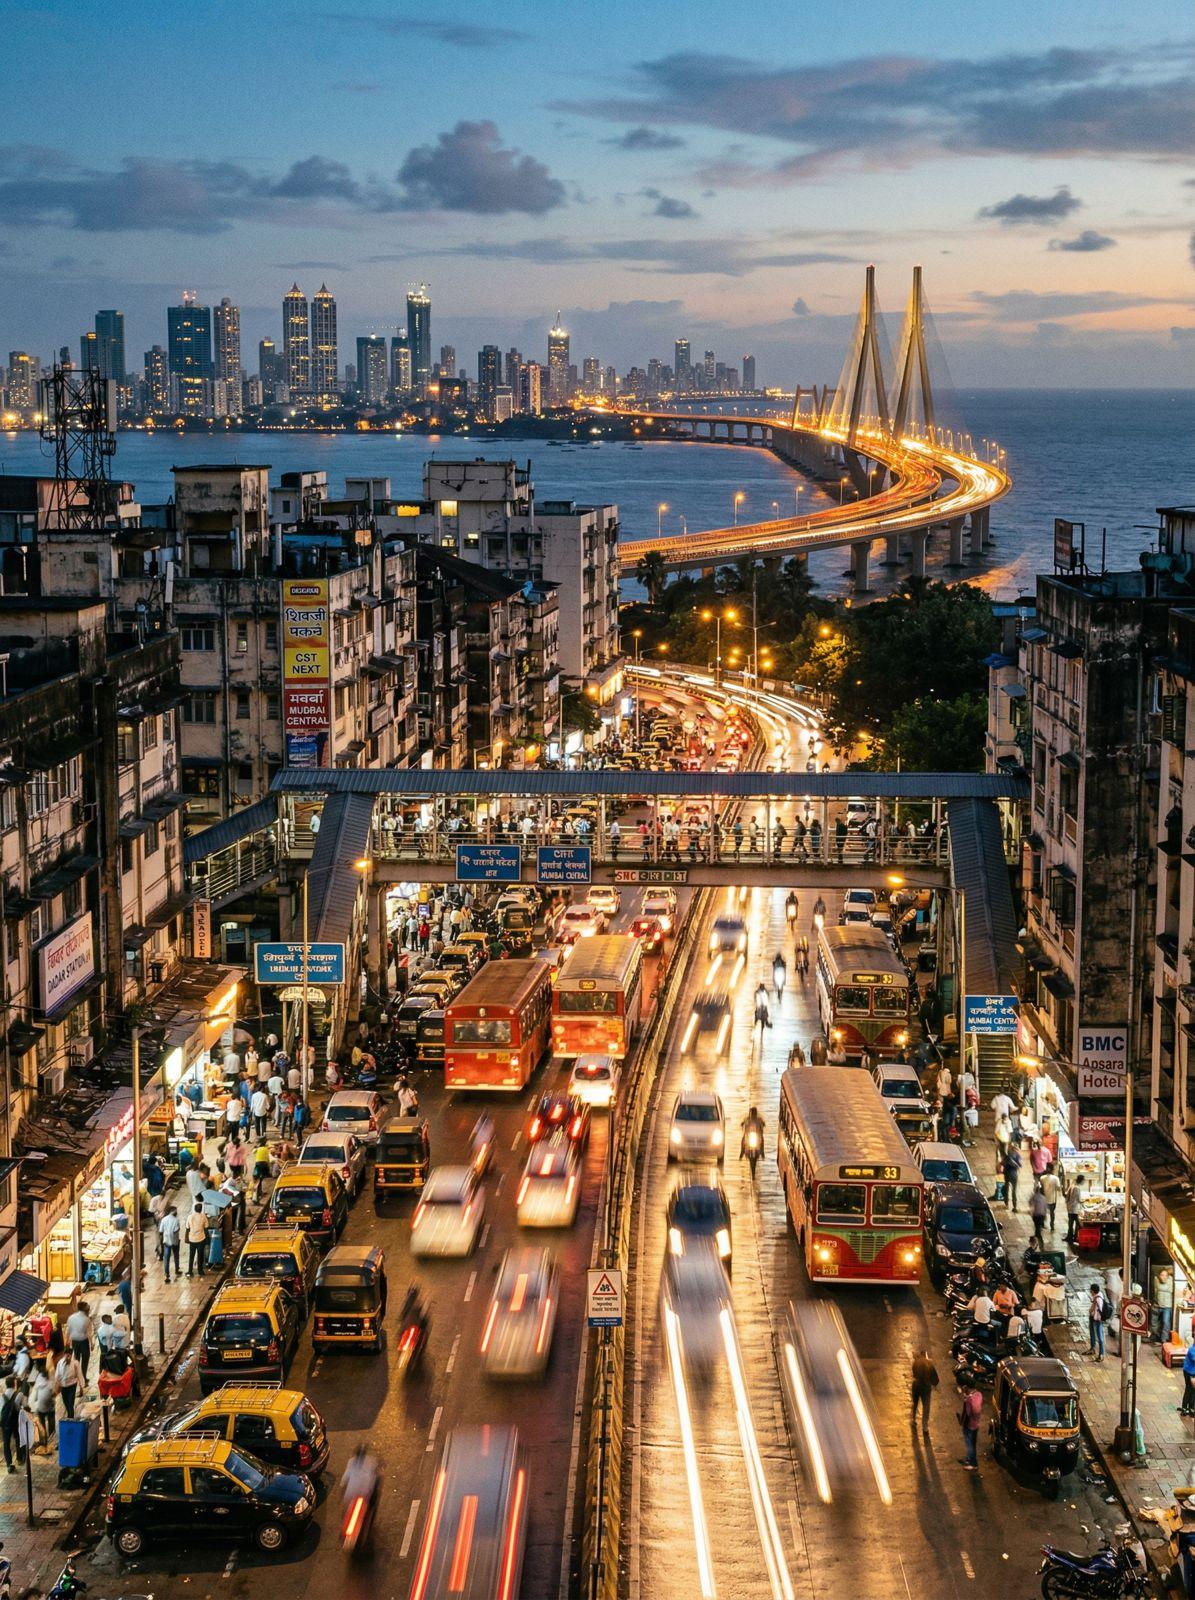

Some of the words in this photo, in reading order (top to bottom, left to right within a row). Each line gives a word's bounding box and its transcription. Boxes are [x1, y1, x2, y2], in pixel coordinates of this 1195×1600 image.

[295, 653, 317, 663] CST
[292, 664, 321, 674] NEXT
[286, 716, 330, 725] CENTRAL
[993, 1017, 1018, 1025] CENTRA
[1082, 1036, 1125, 1051] BMC
[1082, 1057, 1124, 1073] Apsara
[1083, 1075, 1121, 1088] Hotel
[884, 1167, 898, 1179] 33
